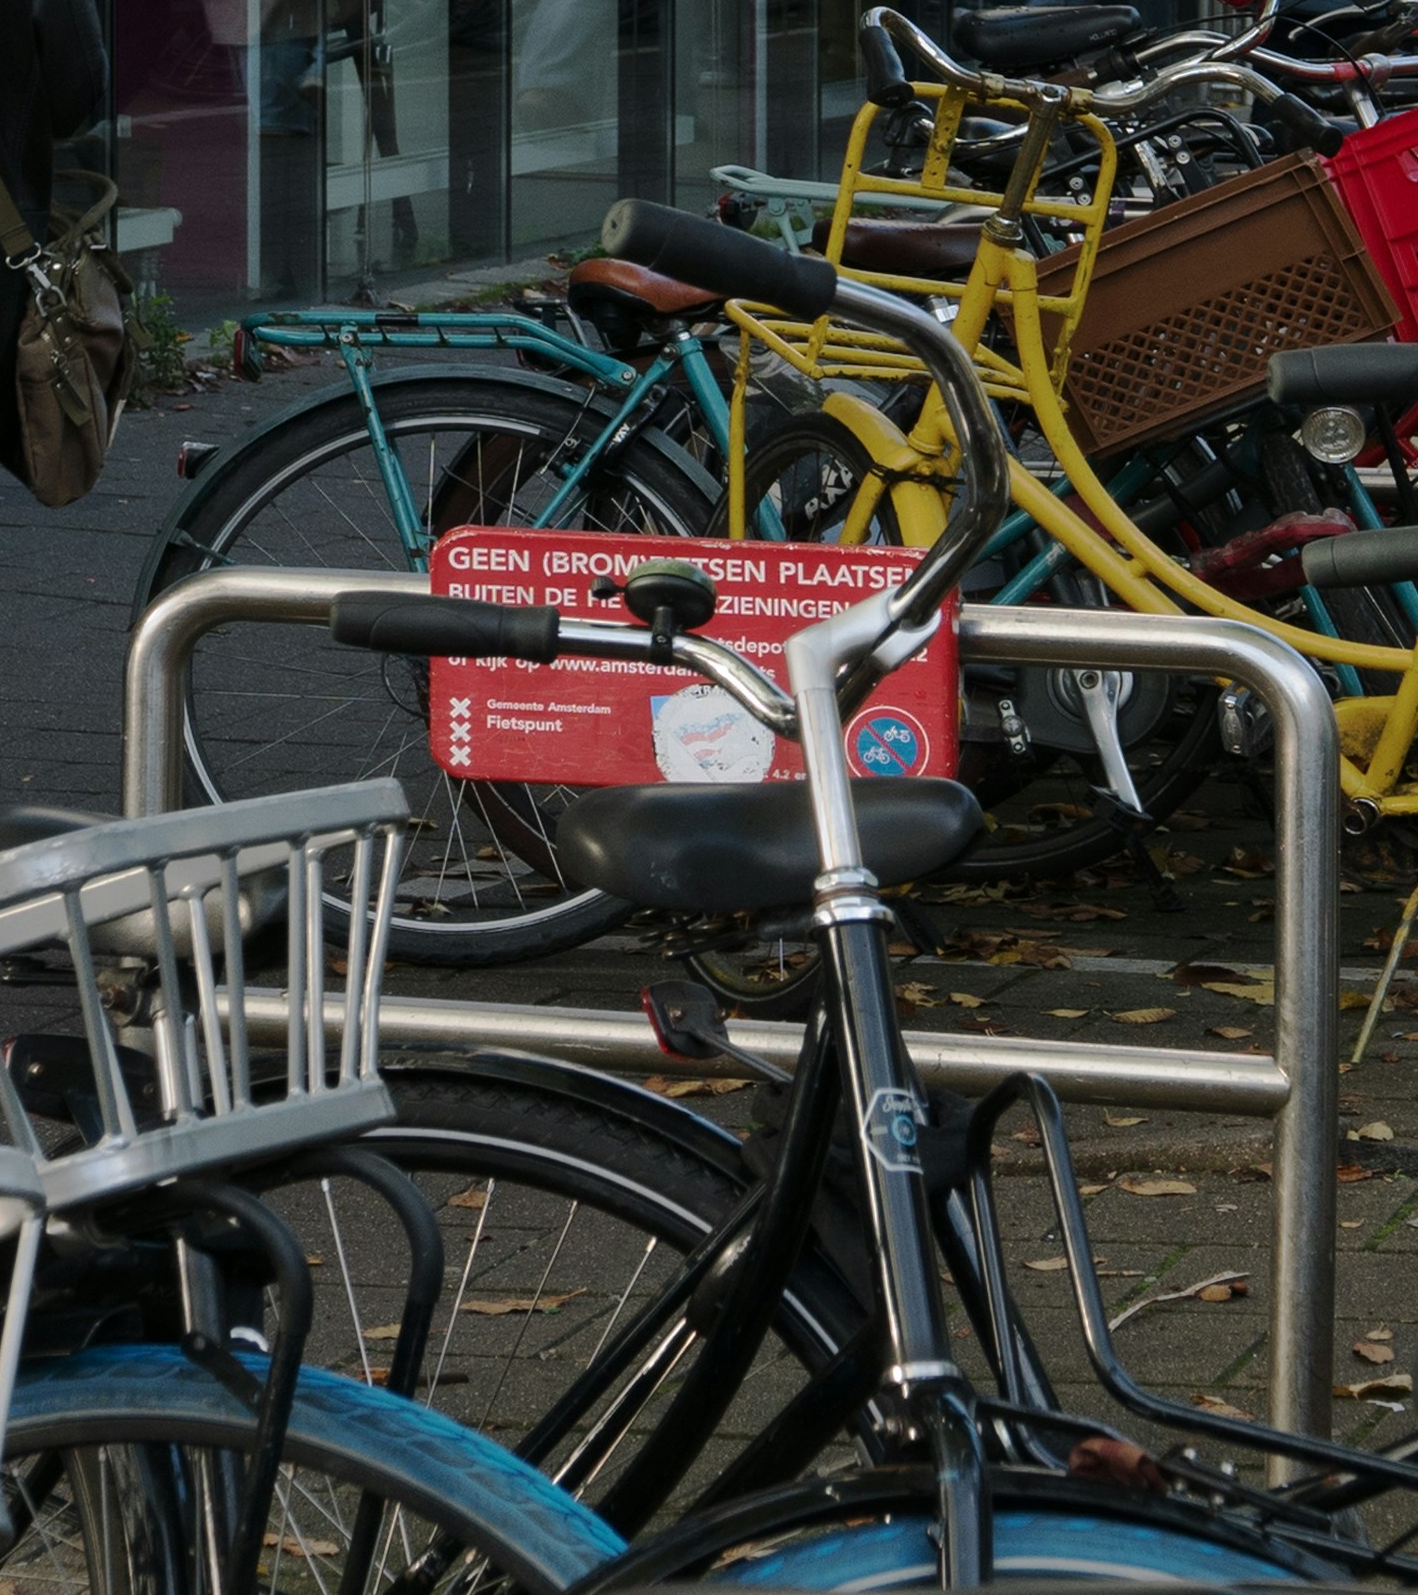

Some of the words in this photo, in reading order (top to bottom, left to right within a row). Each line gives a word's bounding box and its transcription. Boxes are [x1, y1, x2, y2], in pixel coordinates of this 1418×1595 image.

[448, 546, 530, 573] GEEN
[543, 551, 767, 583] (BROMTSEN
[448, 584, 546, 607] BUITEN
[544, 587, 578, 607] DE
[486, 698, 545, 712] Gemeente
[547, 701, 612, 715] Amsterdam
[486, 715, 563, 734] Fietspunt
